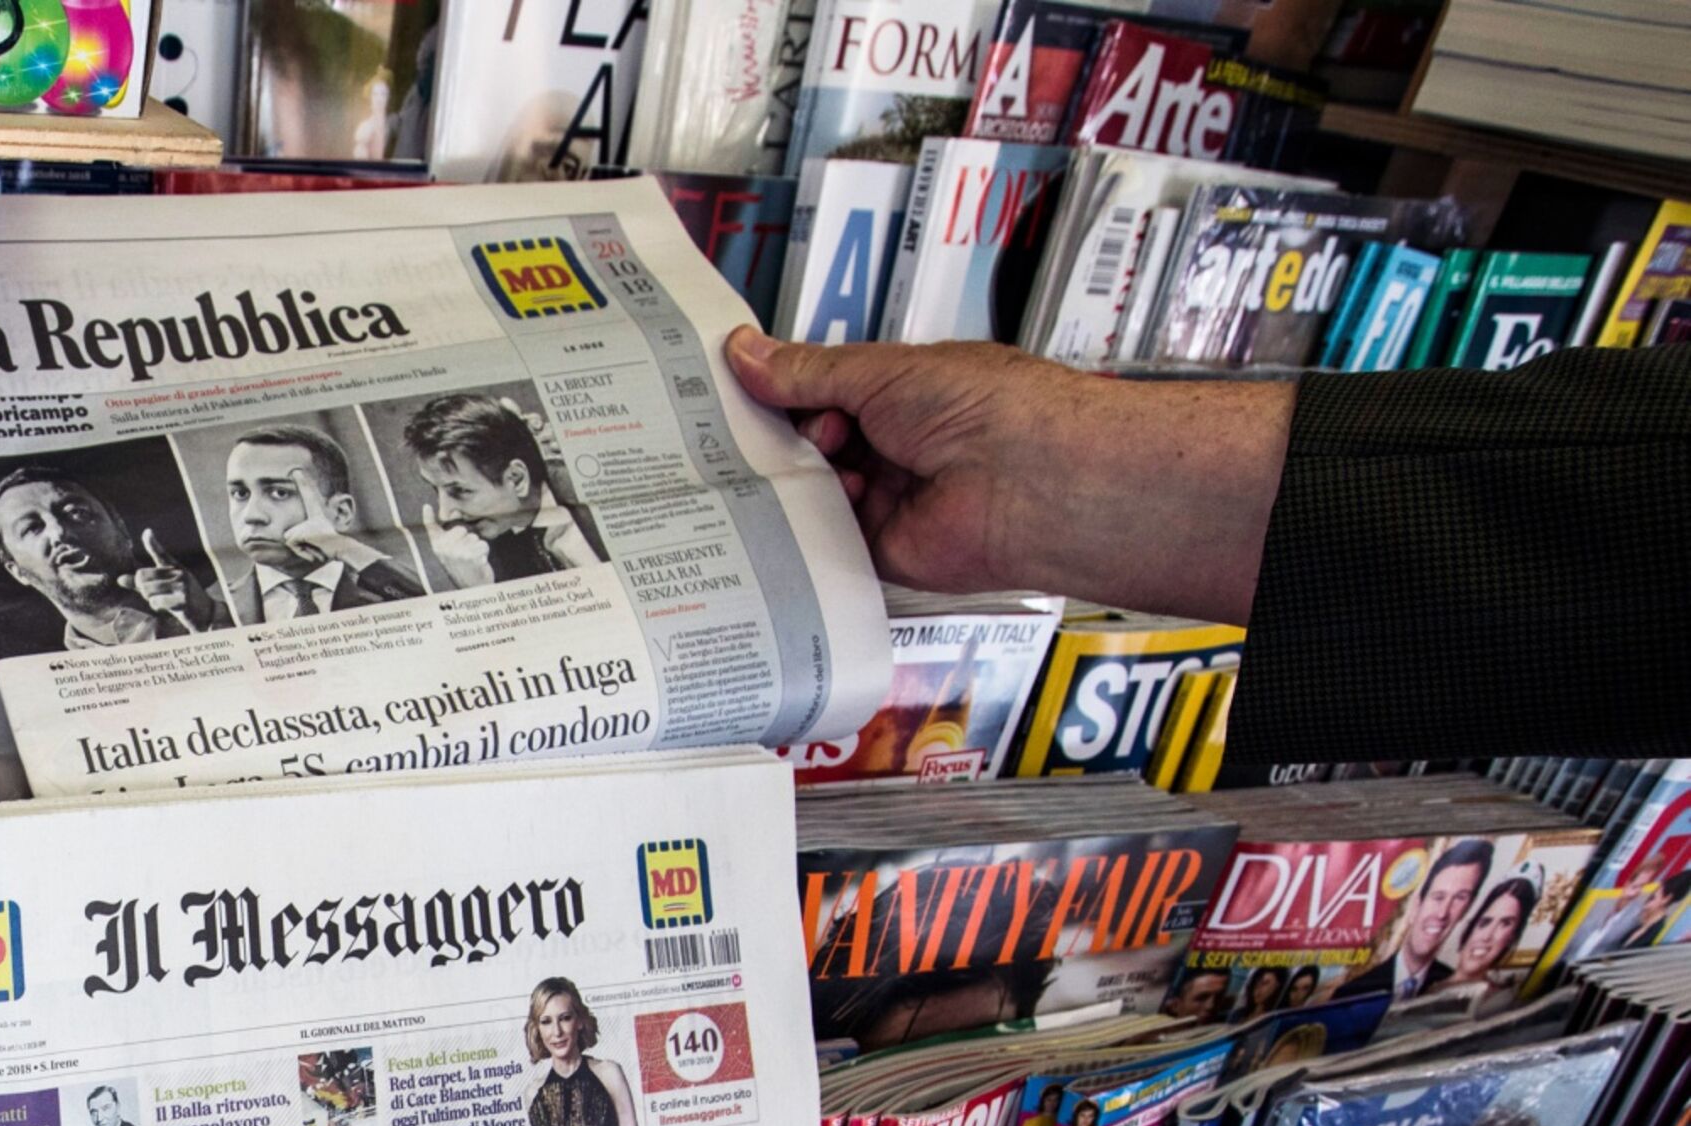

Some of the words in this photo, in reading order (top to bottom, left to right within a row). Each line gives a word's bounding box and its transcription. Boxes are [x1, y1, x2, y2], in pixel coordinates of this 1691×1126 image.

[1078, 42, 1233, 161] Arte
[592, 240, 625, 259] 20
[499, 265, 572, 294] MD
[18, 287, 410, 382] Repubblica
[566, 374, 613, 391] BREXIT
[550, 393, 593, 408] CIECA
[575, 403, 628, 419] LONDRA
[917, 625, 968, 645] MADE
[991, 622, 1041, 644] ITALY
[77, 734, 182, 776] Italia
[186, 703, 382, 757] declassata,
[383, 680, 513, 735] capitali
[561, 655, 636, 694] fuga
[509, 703, 650, 754] condono
[925, 759, 971, 777] Focus
[650, 867, 697, 899] MD
[1208, 852, 1383, 933] DIVA
[804, 858, 1048, 980] VANITY
[1038, 850, 1202, 959] FAIR
[83, 898, 169, 998] Il
[180, 876, 586, 988] Messaggero
[444, 1045, 498, 1066] cinema
[668, 1028, 718, 1057] 140
[176, 1077, 246, 1101] scoperta
[439, 1080, 504, 1103] Blanchett
